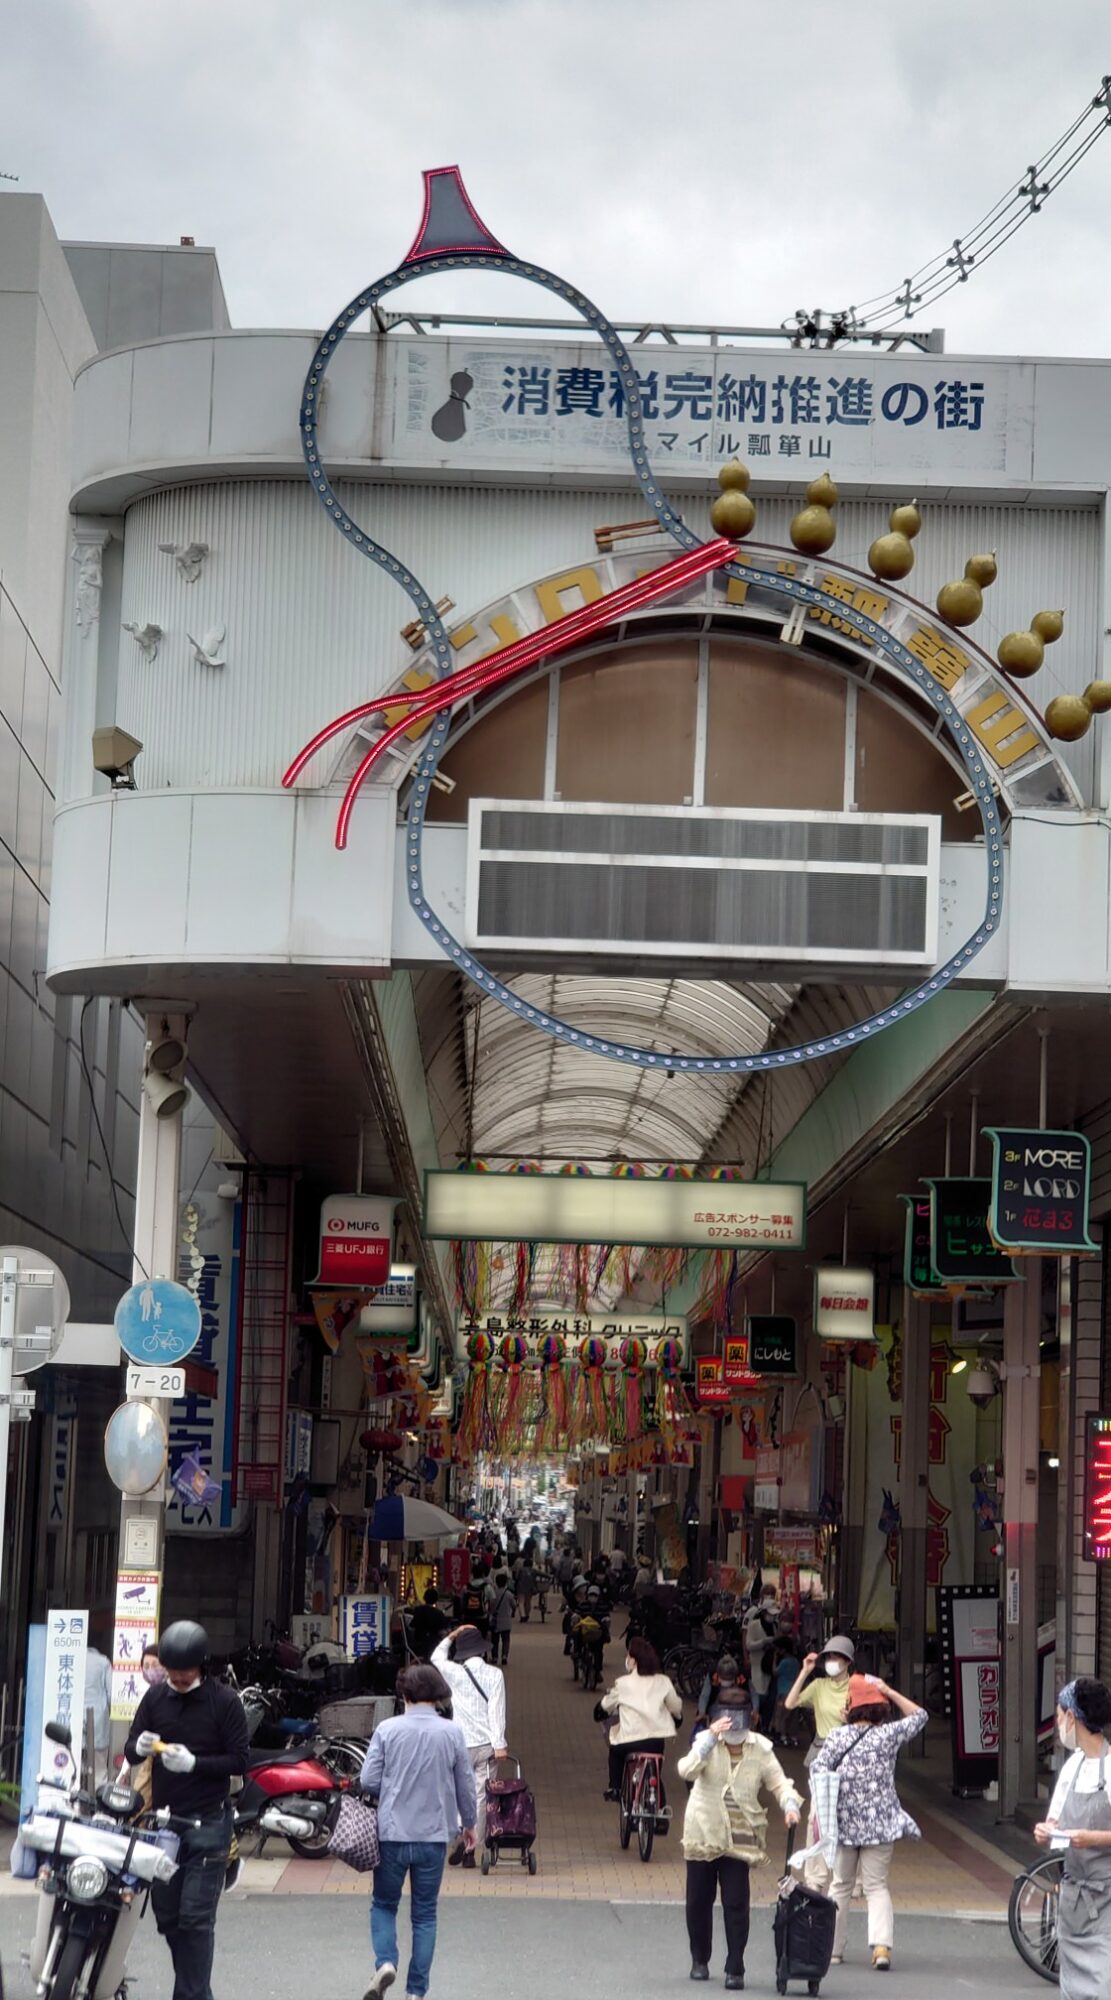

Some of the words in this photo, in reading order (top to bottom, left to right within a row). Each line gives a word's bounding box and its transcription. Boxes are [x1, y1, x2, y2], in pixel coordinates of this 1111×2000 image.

[500, 365, 986, 432] 消費税完納推進の街
[628, 430, 832, 459] マイル瓢箪山
[1004, 1150, 1021, 1162] 3F
[1024, 1148, 1084, 1170] MORE
[1003, 1179, 1020, 1191] 2F
[1023, 1176, 1081, 1199] LORD
[347, 1220, 380, 1232] MUFG
[693, 1211, 795, 1227] 広告スポンサー募集
[707, 1226, 793, 1240] 072-982-0411
[325, 1242, 385, 1256] 三菱UFJ銀行
[754, 1346, 792, 1362] にしもと
[351, 1600, 378, 1658] 賃貸
[53, 1636, 82, 1648] 650m
[977, 1663, 1000, 1750] カラオケ
